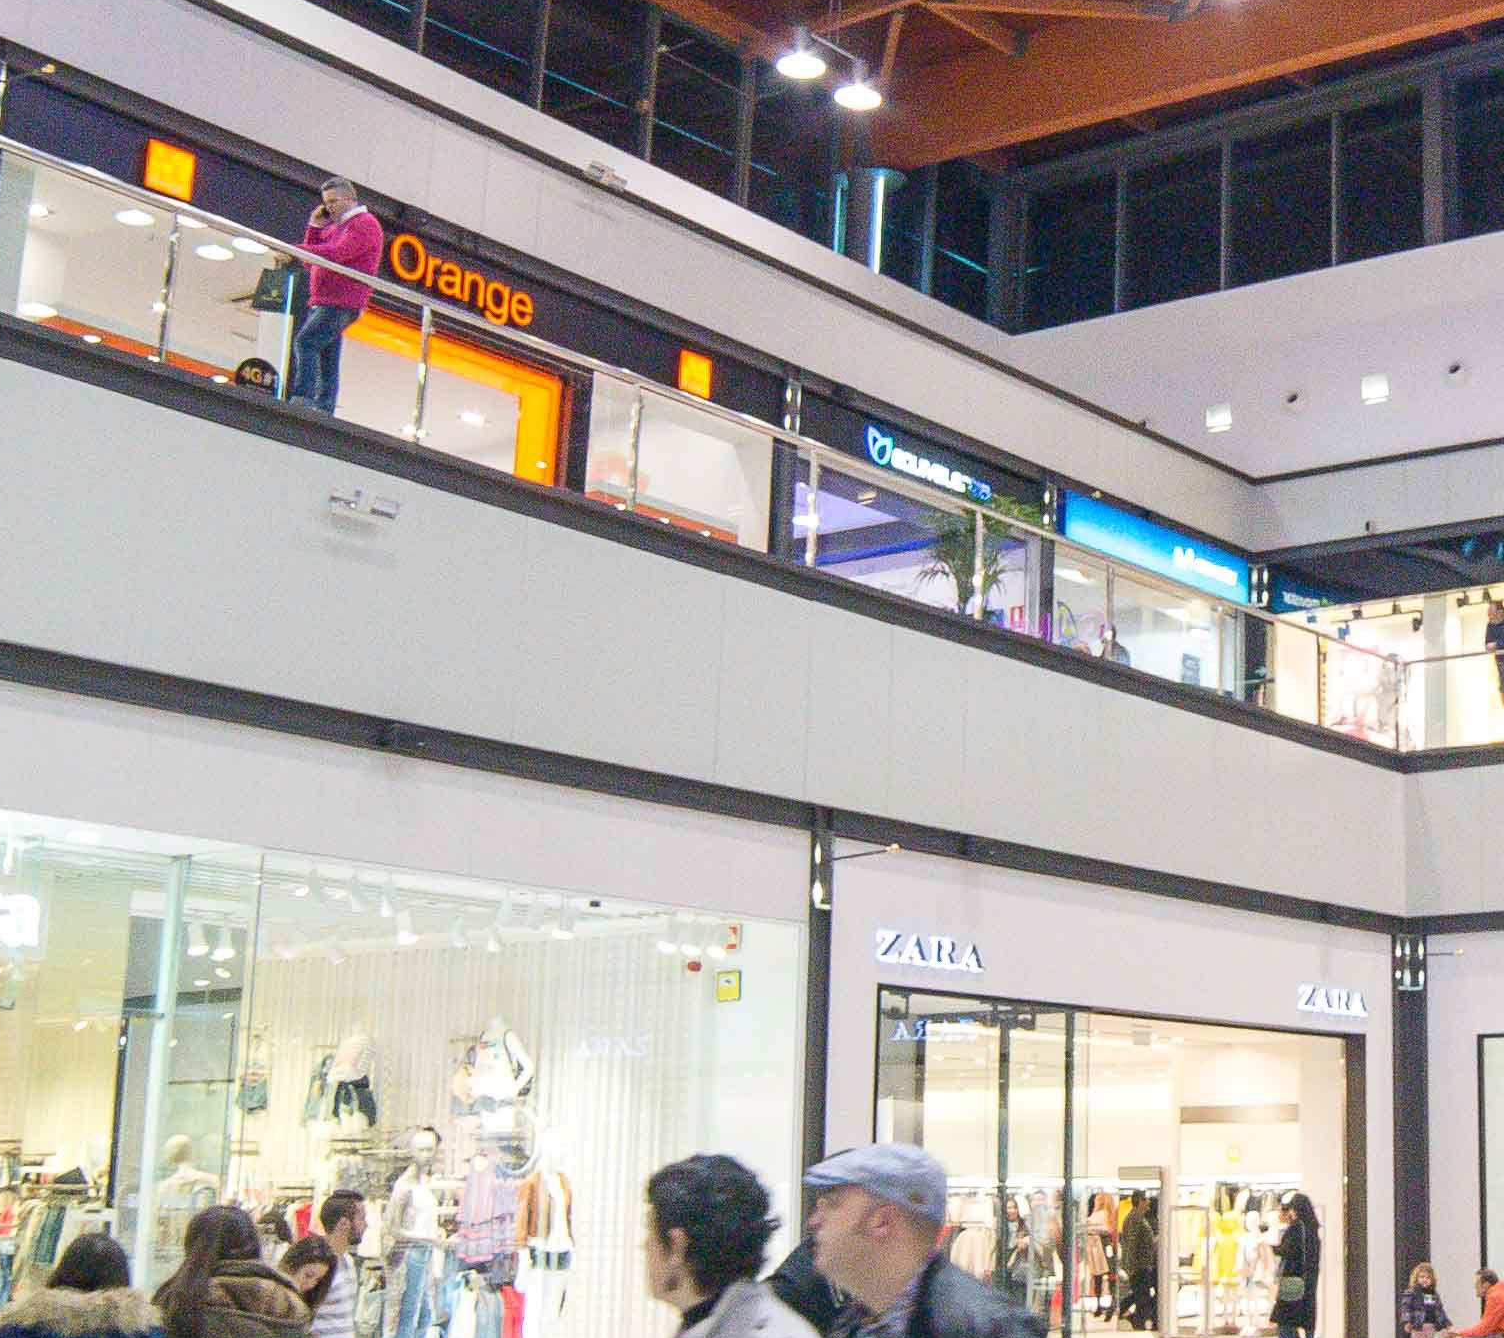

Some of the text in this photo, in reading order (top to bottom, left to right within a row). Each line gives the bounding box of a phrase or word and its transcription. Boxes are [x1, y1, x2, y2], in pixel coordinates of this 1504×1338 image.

[389, 233, 535, 327] Orange
[876, 929, 986, 974] ZARA
[1296, 983, 1369, 1018] ZARA
